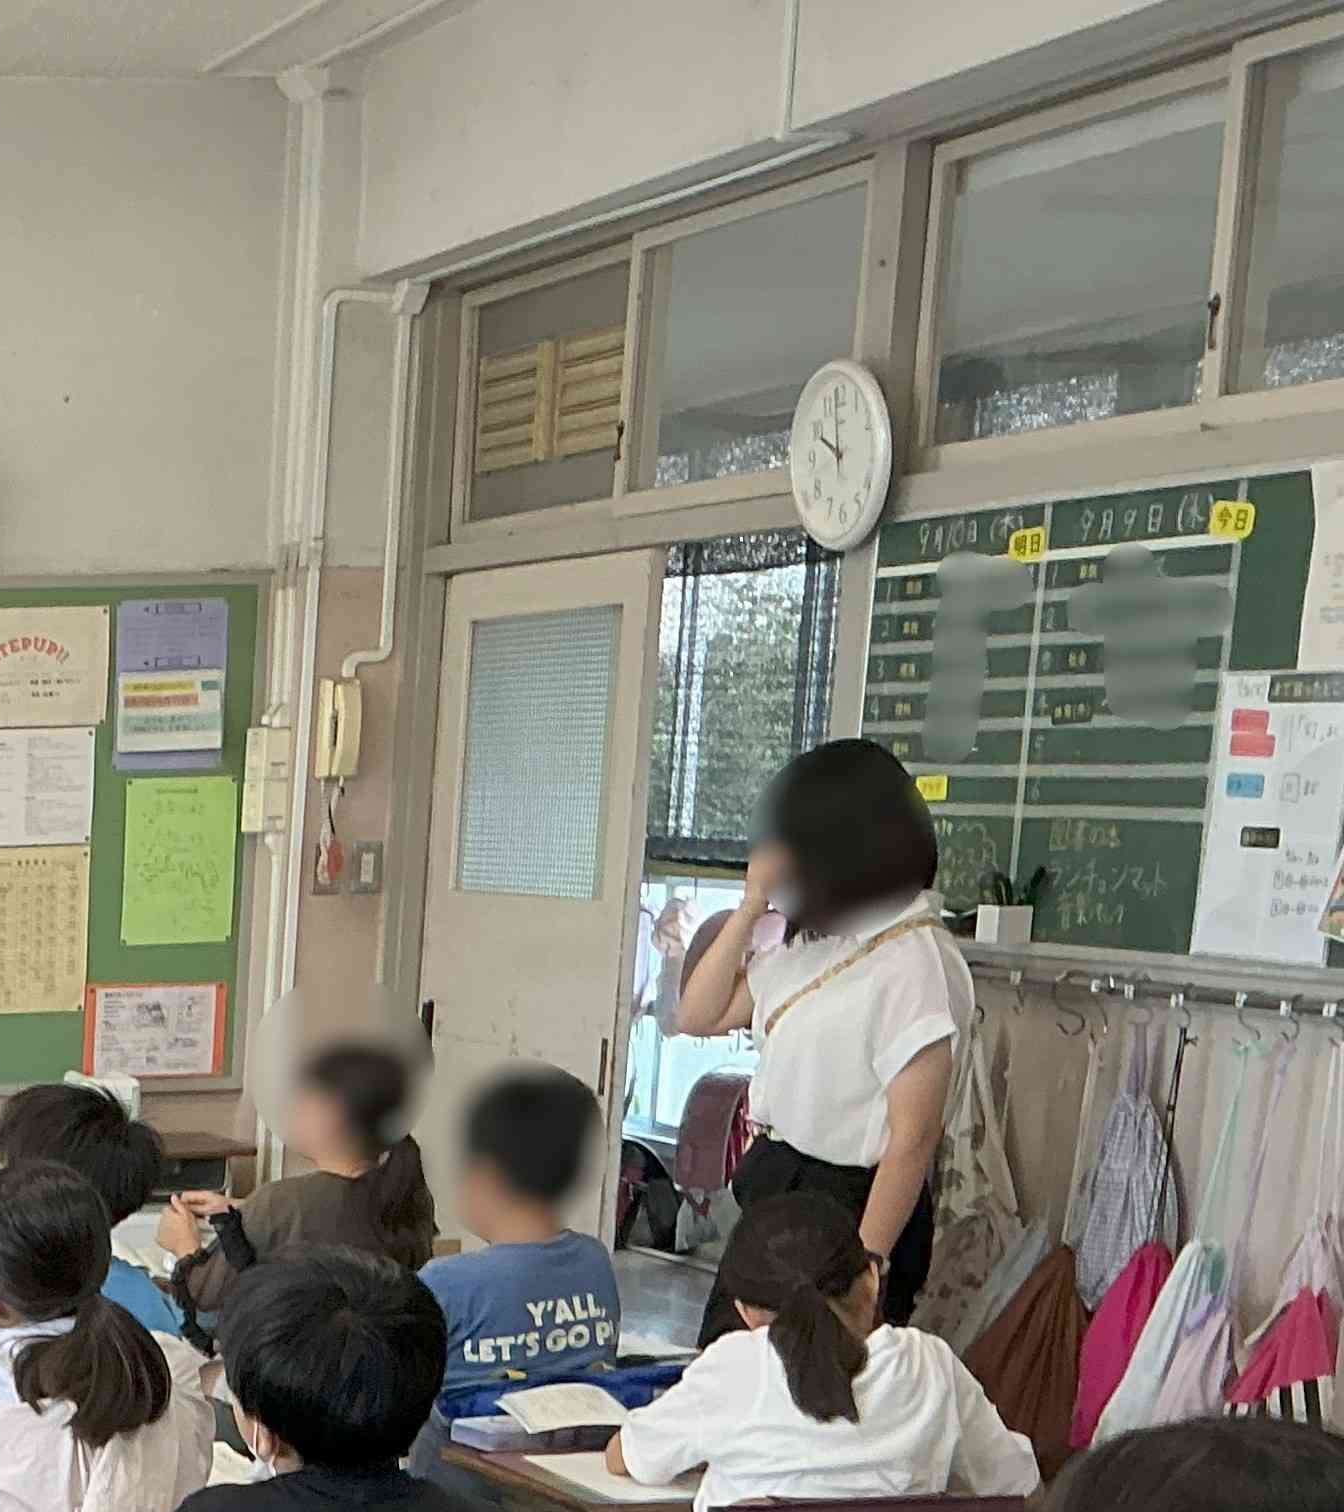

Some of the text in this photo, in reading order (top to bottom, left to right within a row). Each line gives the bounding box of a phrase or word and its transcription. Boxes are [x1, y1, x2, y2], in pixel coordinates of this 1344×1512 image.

[1216, 510, 1249, 532] 今日
[526, 1292, 606, 1327] Y'ALL,
[464, 1331, 540, 1363] LET'S
[545, 1323, 590, 1353] GO
